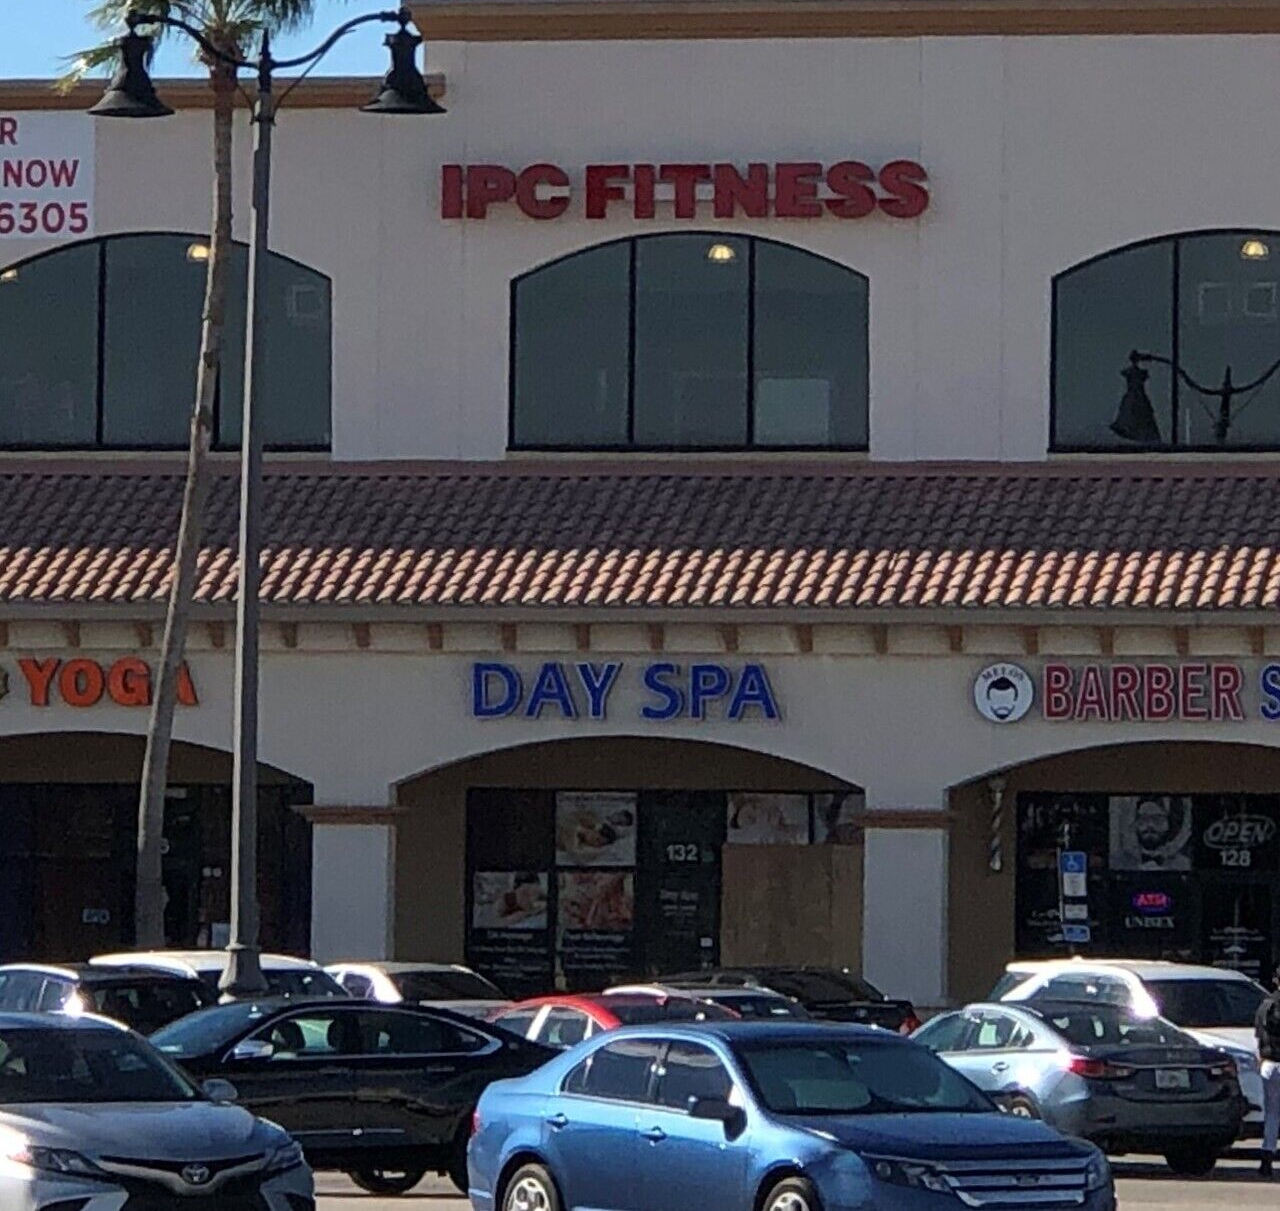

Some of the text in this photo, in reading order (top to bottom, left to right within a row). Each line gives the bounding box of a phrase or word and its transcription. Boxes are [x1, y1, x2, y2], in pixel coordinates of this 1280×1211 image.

[3, 159, 80, 188] NOW
[441, 159, 930, 220] IPC FITNESS
[471, 660, 782, 721] DAY SPA
[1042, 662, 1245, 721] BARBER
[1211, 819, 1266, 844] OPEN
[666, 843, 699, 862] 132
[1220, 849, 1252, 867] 128
